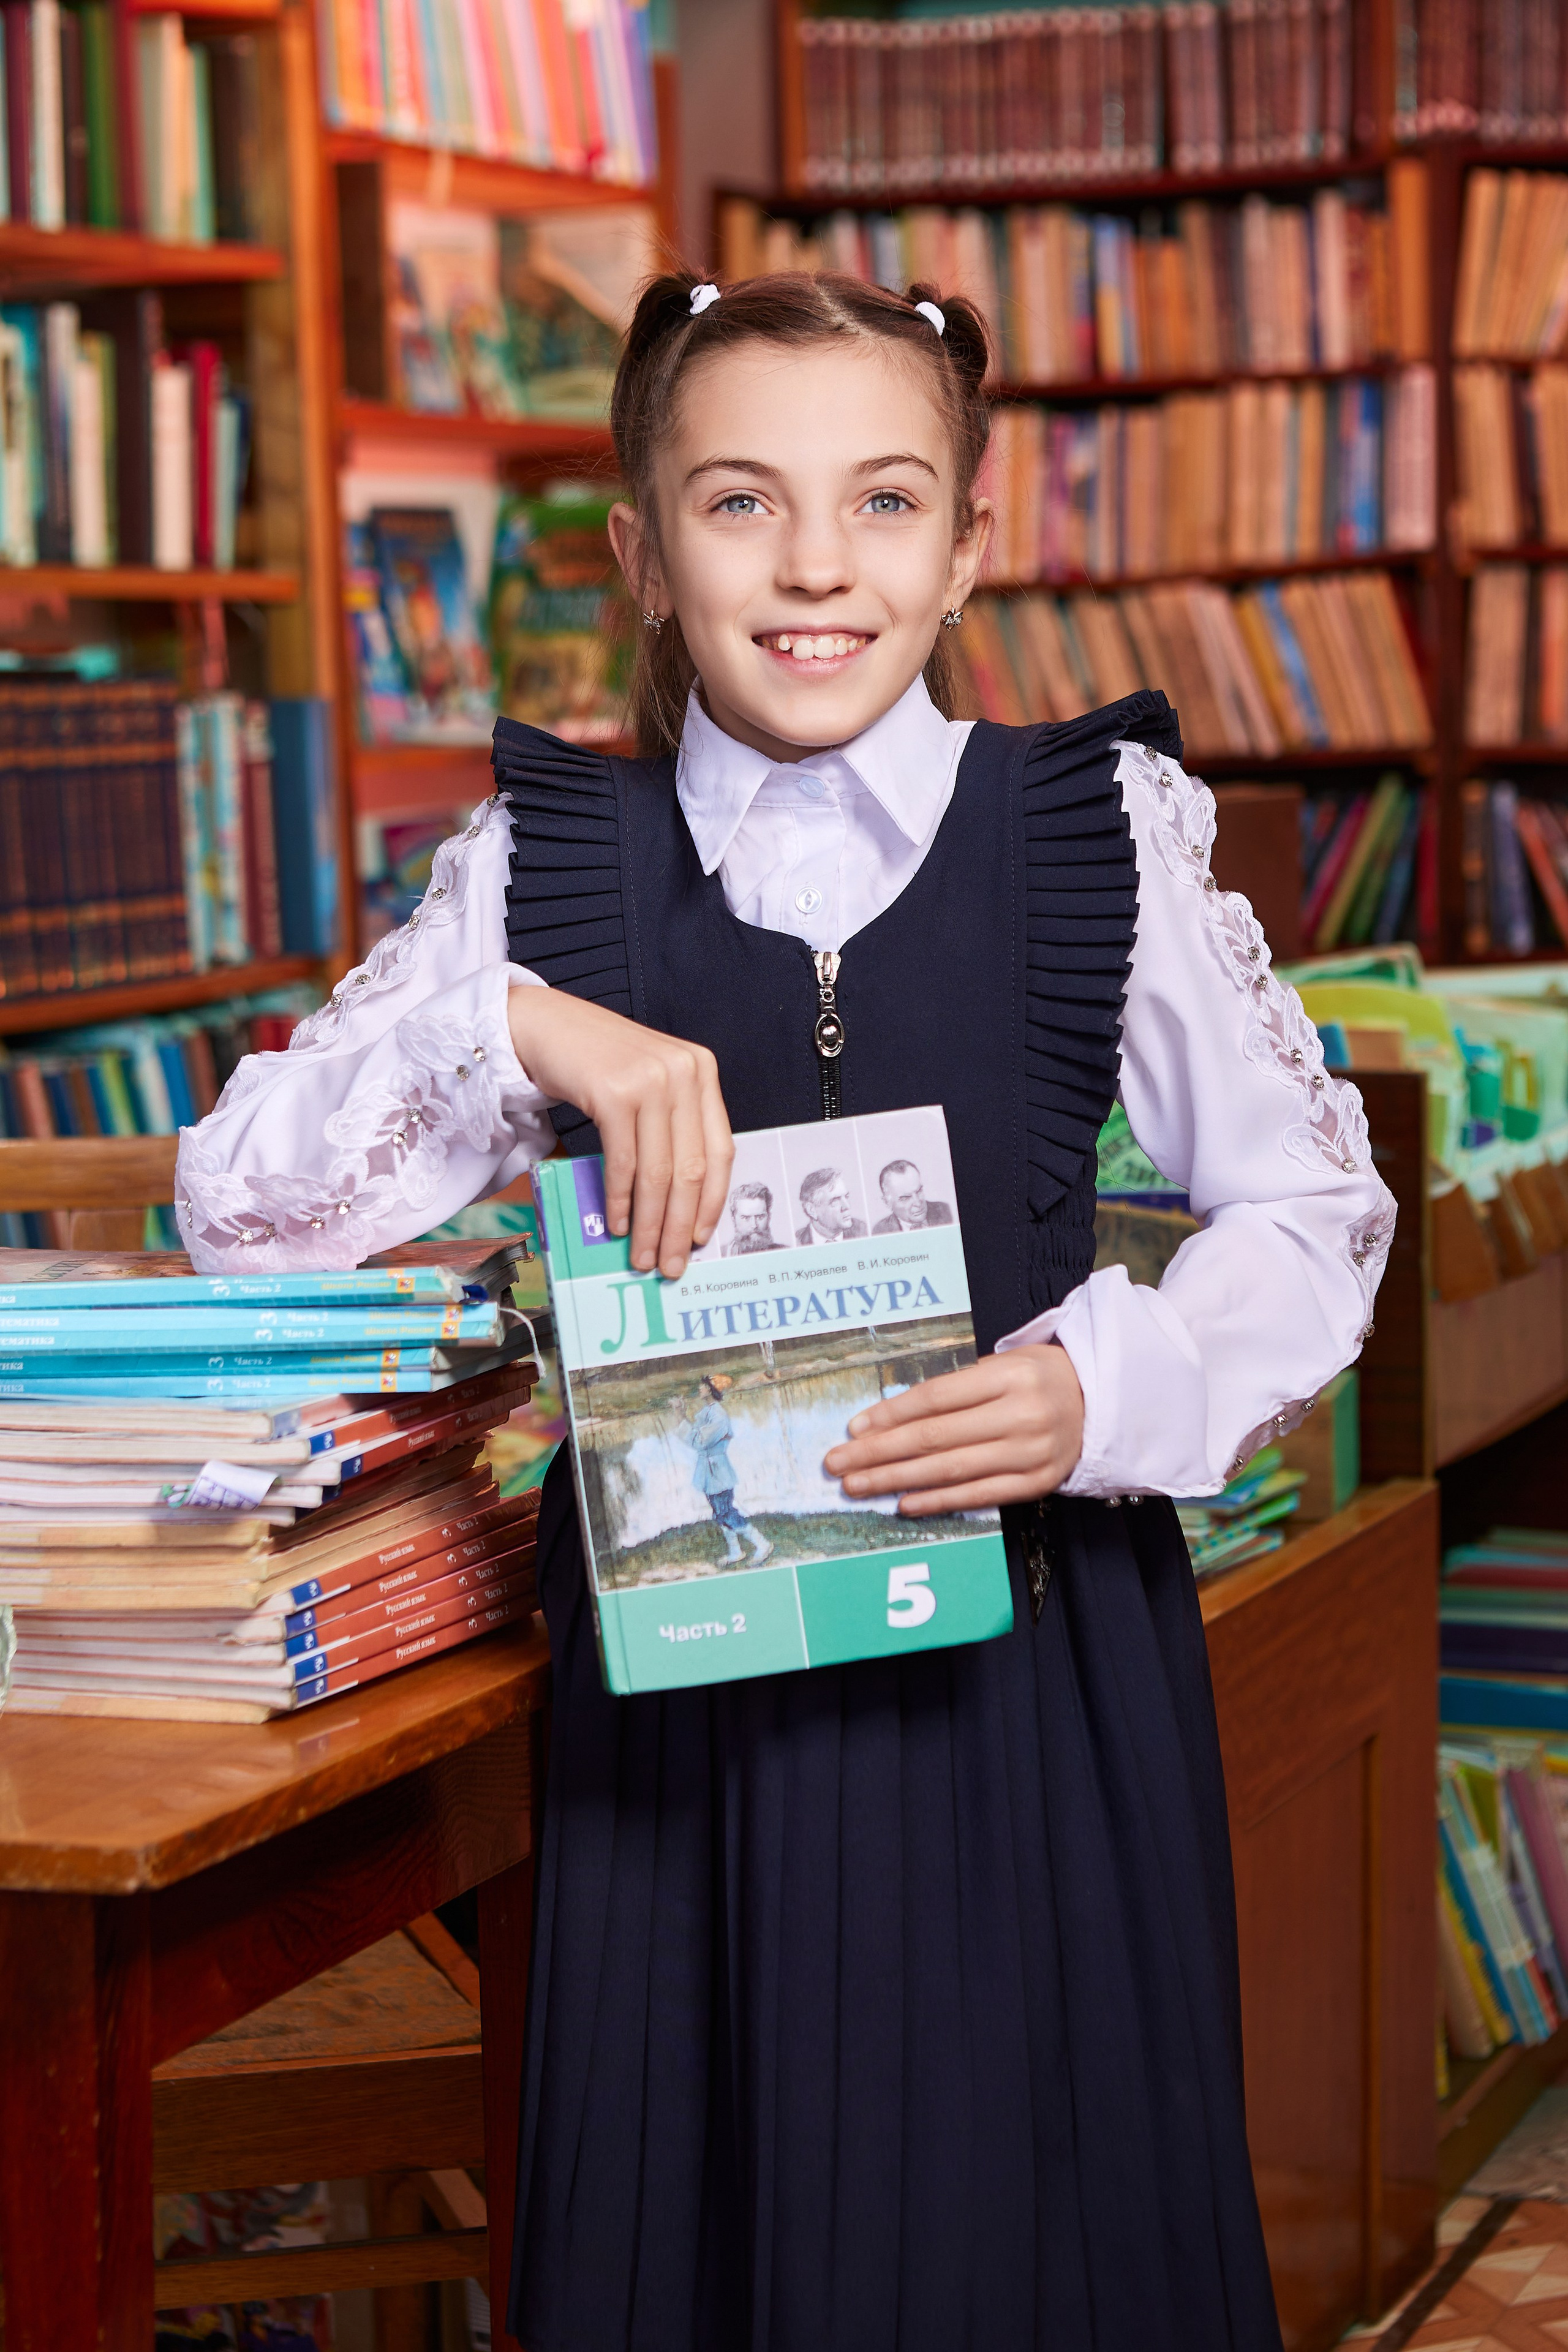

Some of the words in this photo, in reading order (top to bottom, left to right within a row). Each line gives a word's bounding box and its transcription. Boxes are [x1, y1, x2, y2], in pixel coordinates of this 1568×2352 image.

[213, 1285, 230, 1297] 3
[275, 1284, 282, 1292] 2
[259, 1312, 277, 1325] 3
[322, 1312, 329, 1322] 2
[254, 1328, 273, 1341] 3
[317, 1327, 325, 1337] 2
[208, 1357, 224, 1368] 3
[266, 1356, 273, 1365] 2
[207, 1378, 224, 1392] 3
[265, 1379, 271, 1388] 2
[887, 1562, 937, 1629] 5
[659, 1620, 728, 1643] Часть
[731, 1613, 747, 1634] 2
